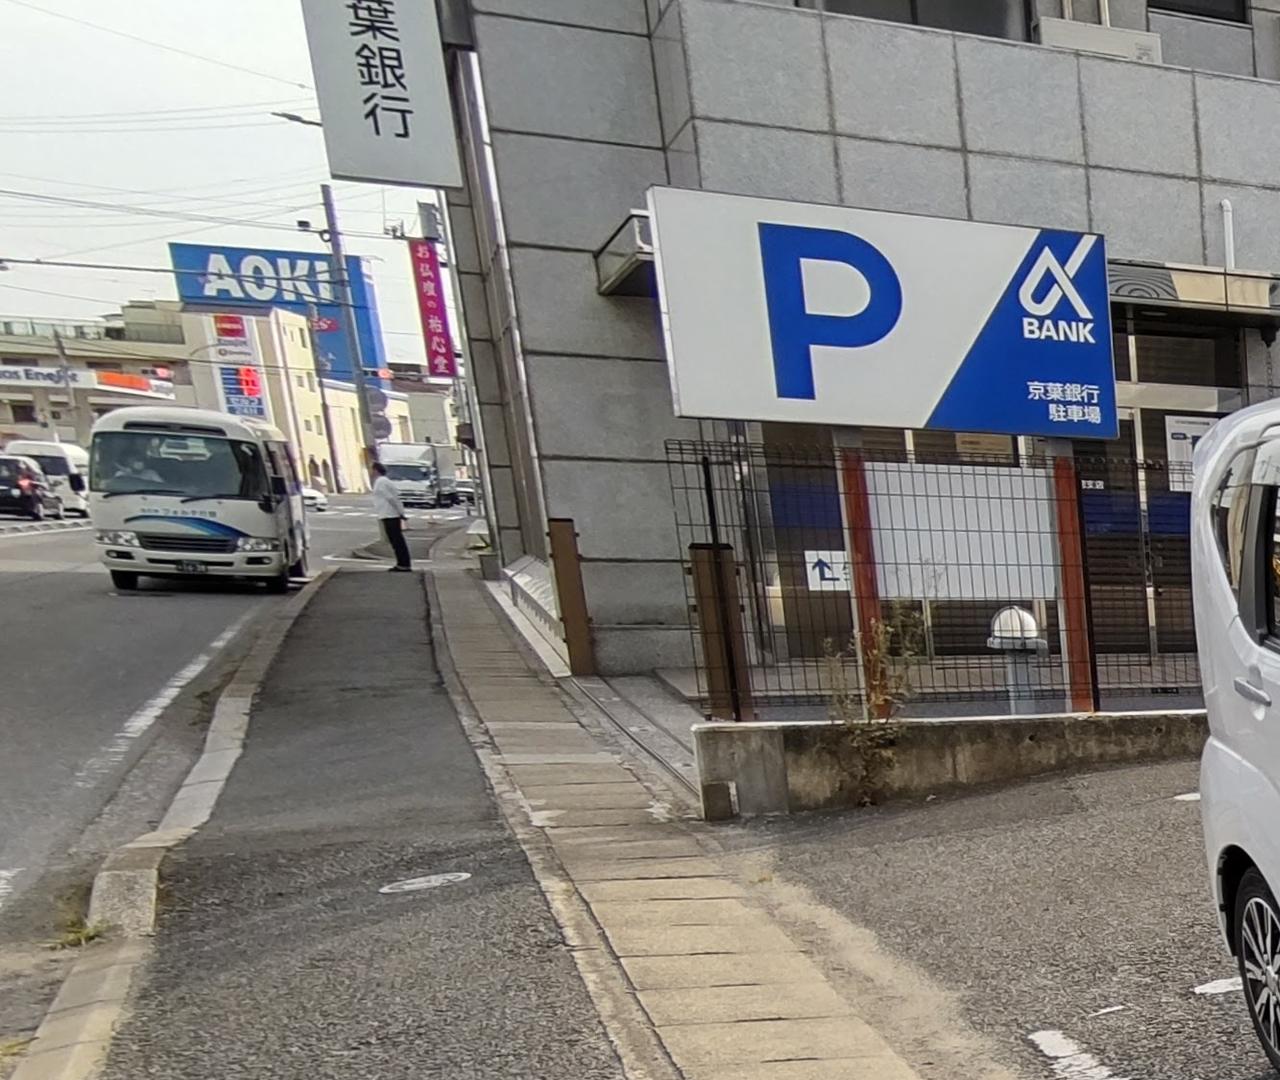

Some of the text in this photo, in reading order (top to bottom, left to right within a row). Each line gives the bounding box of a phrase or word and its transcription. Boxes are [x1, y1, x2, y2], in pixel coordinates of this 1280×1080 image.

[203, 254, 335, 303] AOKI
[757, 222, 903, 400] P
[1022, 317, 1096, 344] BANK
[1027, 381, 1100, 403] 京葉銀行
[1048, 403, 1101, 424] 駐車場
